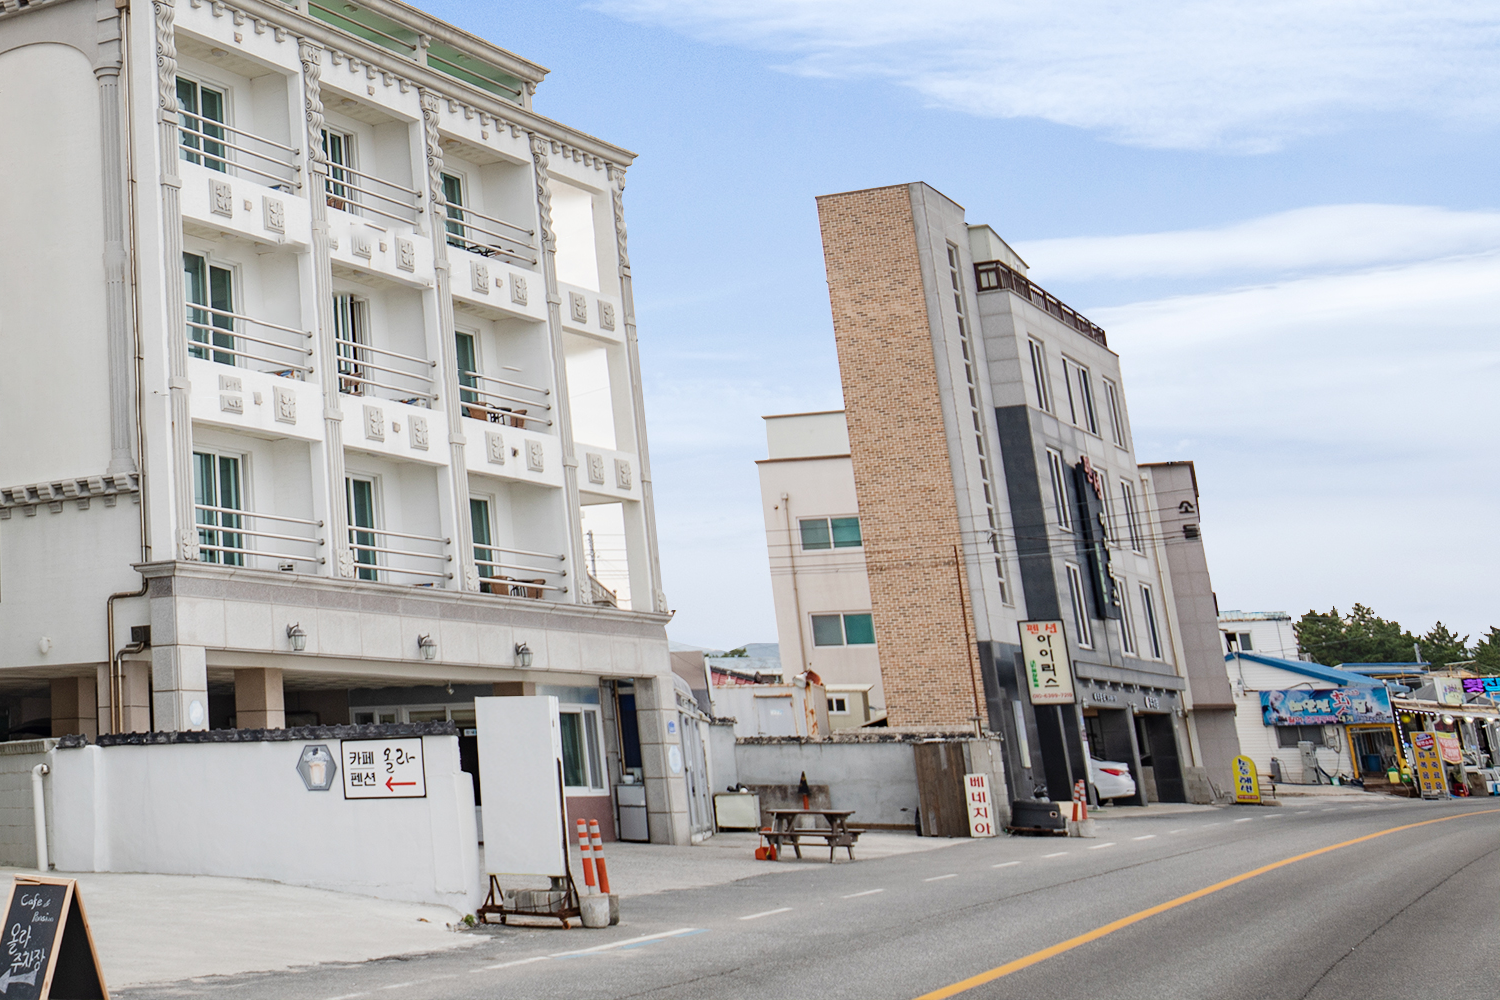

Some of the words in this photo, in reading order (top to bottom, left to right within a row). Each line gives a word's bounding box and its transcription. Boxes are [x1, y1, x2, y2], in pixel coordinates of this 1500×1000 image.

[1026, 623, 1057, 634] 펜션
[1037, 634, 1060, 688] 아이리스
[349, 751, 374, 765] 카페
[350, 772, 376, 787] 펜션
[969, 776, 991, 835] 베네지아
[20, 893, 42, 910] Cafe
[7, 922, 31, 955] 올라
[10, 948, 45, 974] 주차장
